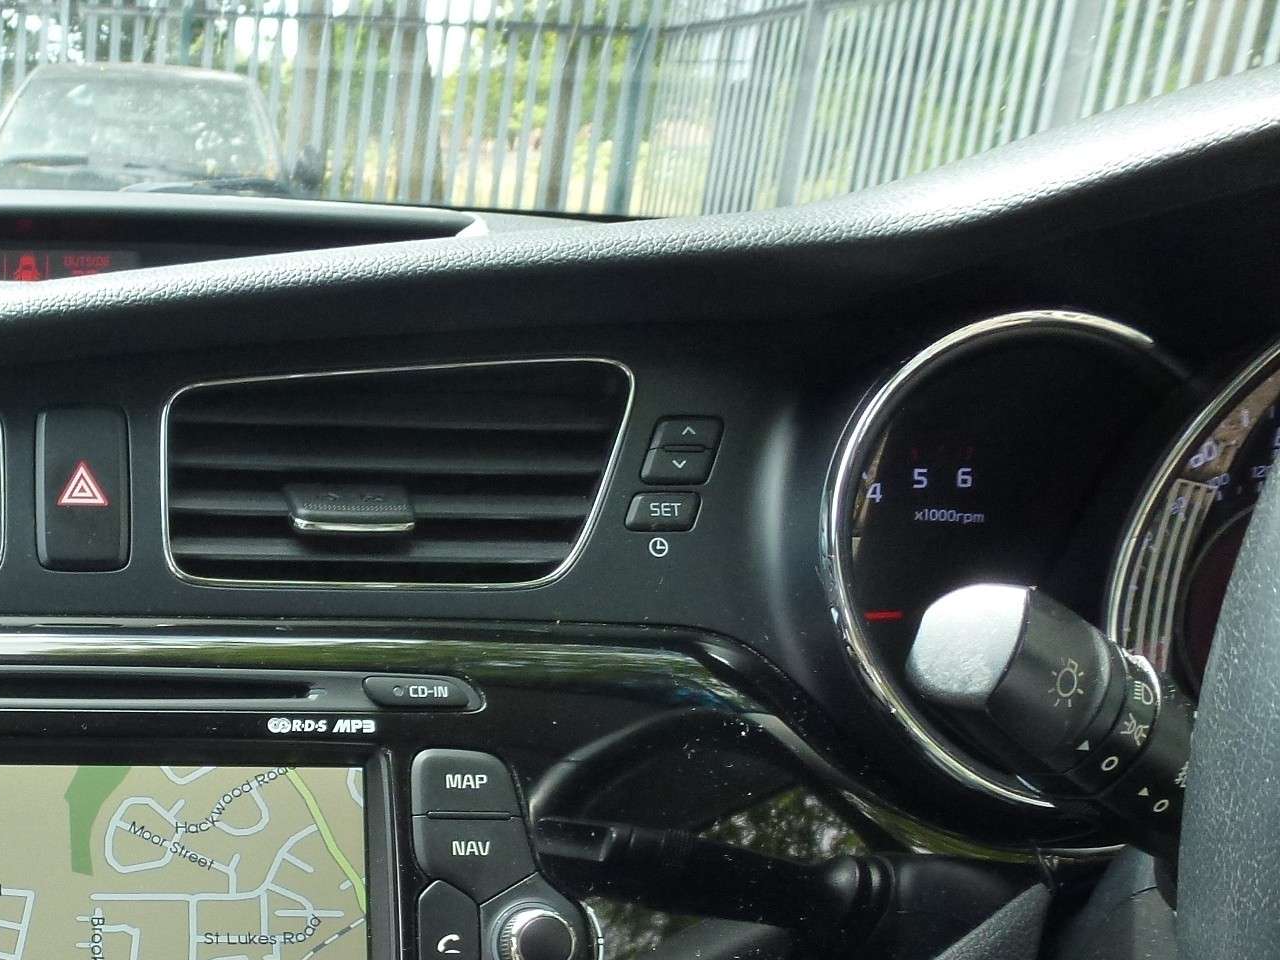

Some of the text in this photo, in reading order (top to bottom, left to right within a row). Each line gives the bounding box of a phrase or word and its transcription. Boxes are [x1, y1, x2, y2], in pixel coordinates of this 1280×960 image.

[865, 467, 973, 502] 4 5 6
[649, 502, 682, 517] SET
[409, 685, 449, 698] CD-IN
[332, 719, 376, 733] MP3
[445, 774, 488, 790] MAP
[175, 767, 297, 833] Hackwood Roa
[128, 821, 215, 870] Moor Street
[452, 840, 490, 856] NAV
[204, 913, 322, 945] St Lukes Road
